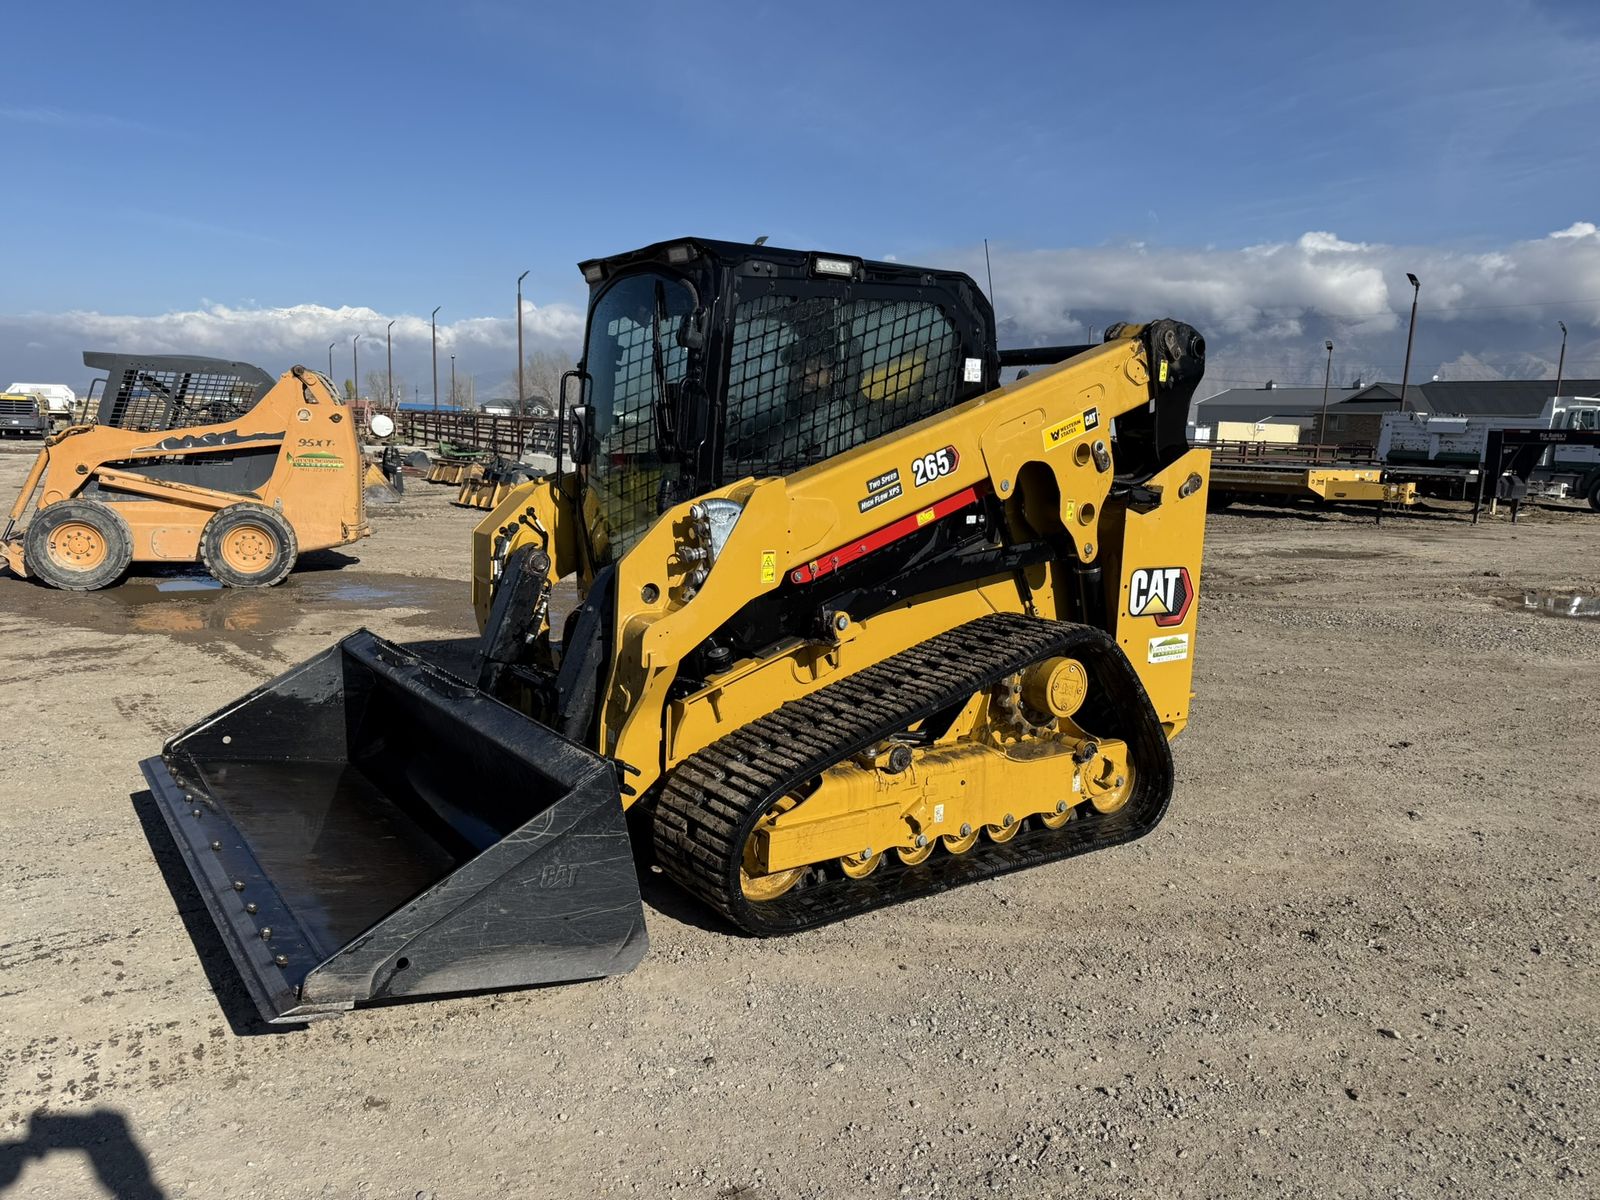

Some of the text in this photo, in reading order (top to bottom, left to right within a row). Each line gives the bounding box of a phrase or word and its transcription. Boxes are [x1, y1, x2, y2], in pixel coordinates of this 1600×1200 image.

[1060, 428, 1077, 439] STATES
[912, 448, 950, 487] 265
[888, 485, 900, 497] XPS
[1128, 568, 1181, 616] CAT
[540, 864, 579, 888] CAT
